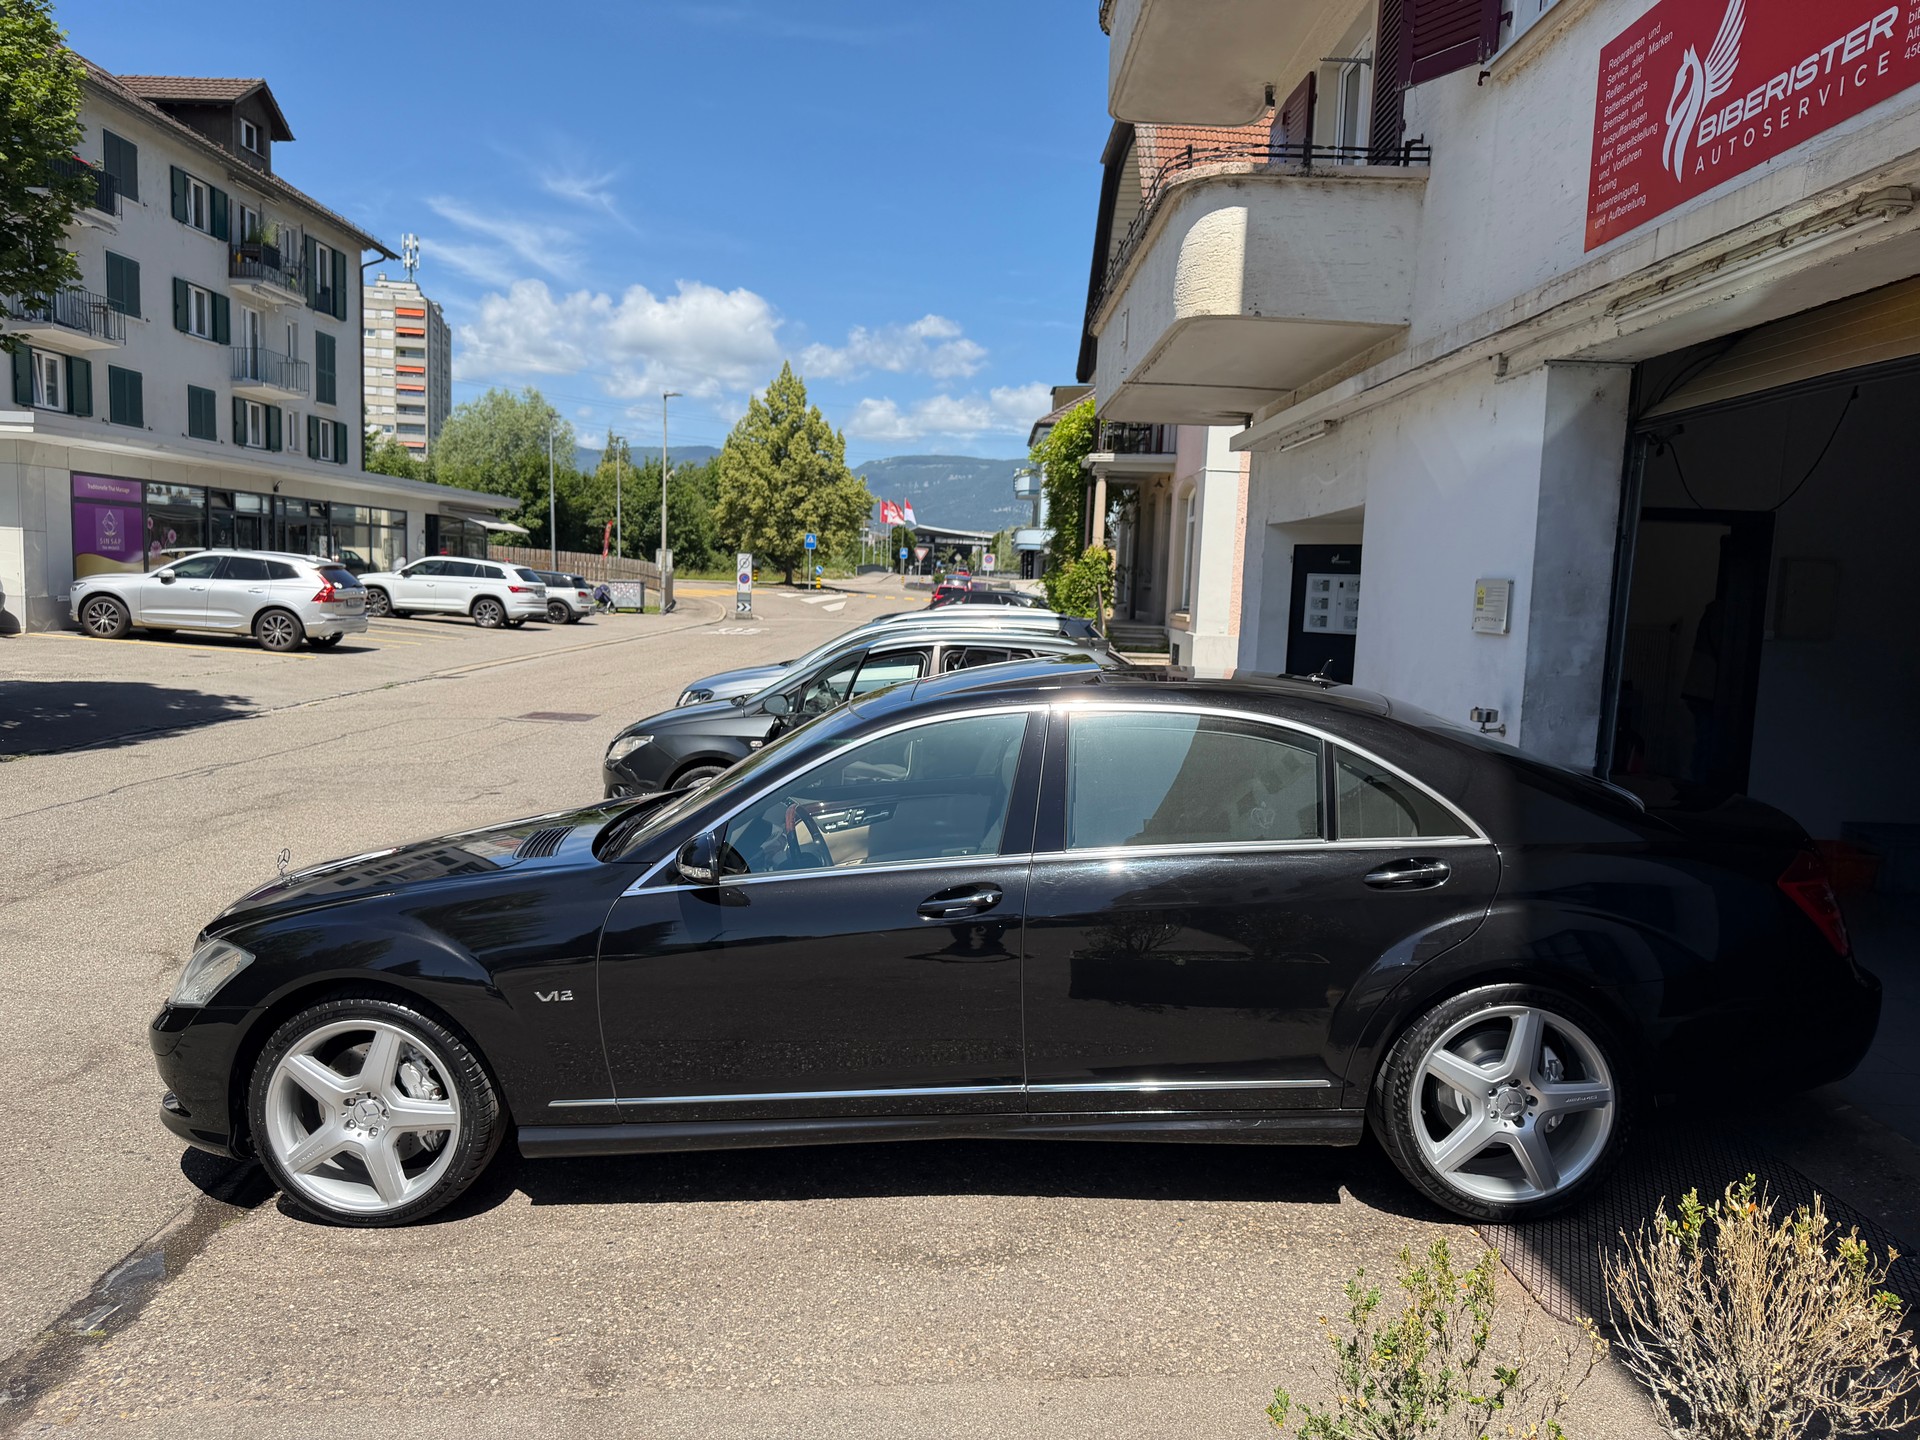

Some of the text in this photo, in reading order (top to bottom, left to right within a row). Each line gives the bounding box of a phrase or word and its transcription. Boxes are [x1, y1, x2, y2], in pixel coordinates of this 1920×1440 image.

[1606, 31, 1674, 86] Service aller Marken
[1608, 21, 1662, 71] Reparaturen und
[1605, 66, 1642, 102] Reifen- und
[1696, 5, 1899, 148] BIBERISTER
[1602, 95, 1645, 133] Bremsen und
[1603, 80, 1649, 118] Batterieservice
[1694, 50, 1891, 175] AUTOSERVICE
[1599, 122, 1659, 166] MFK Bereitstellung
[1601, 111, 1648, 148] Auspuffanlagen
[1598, 165, 1610, 182] und
[1598, 178, 1617, 195] Tuning
[1594, 194, 1647, 229] und Aufbereitung
[1595, 182, 1640, 213] Innenreinigung
[533, 989, 574, 1002] V12
